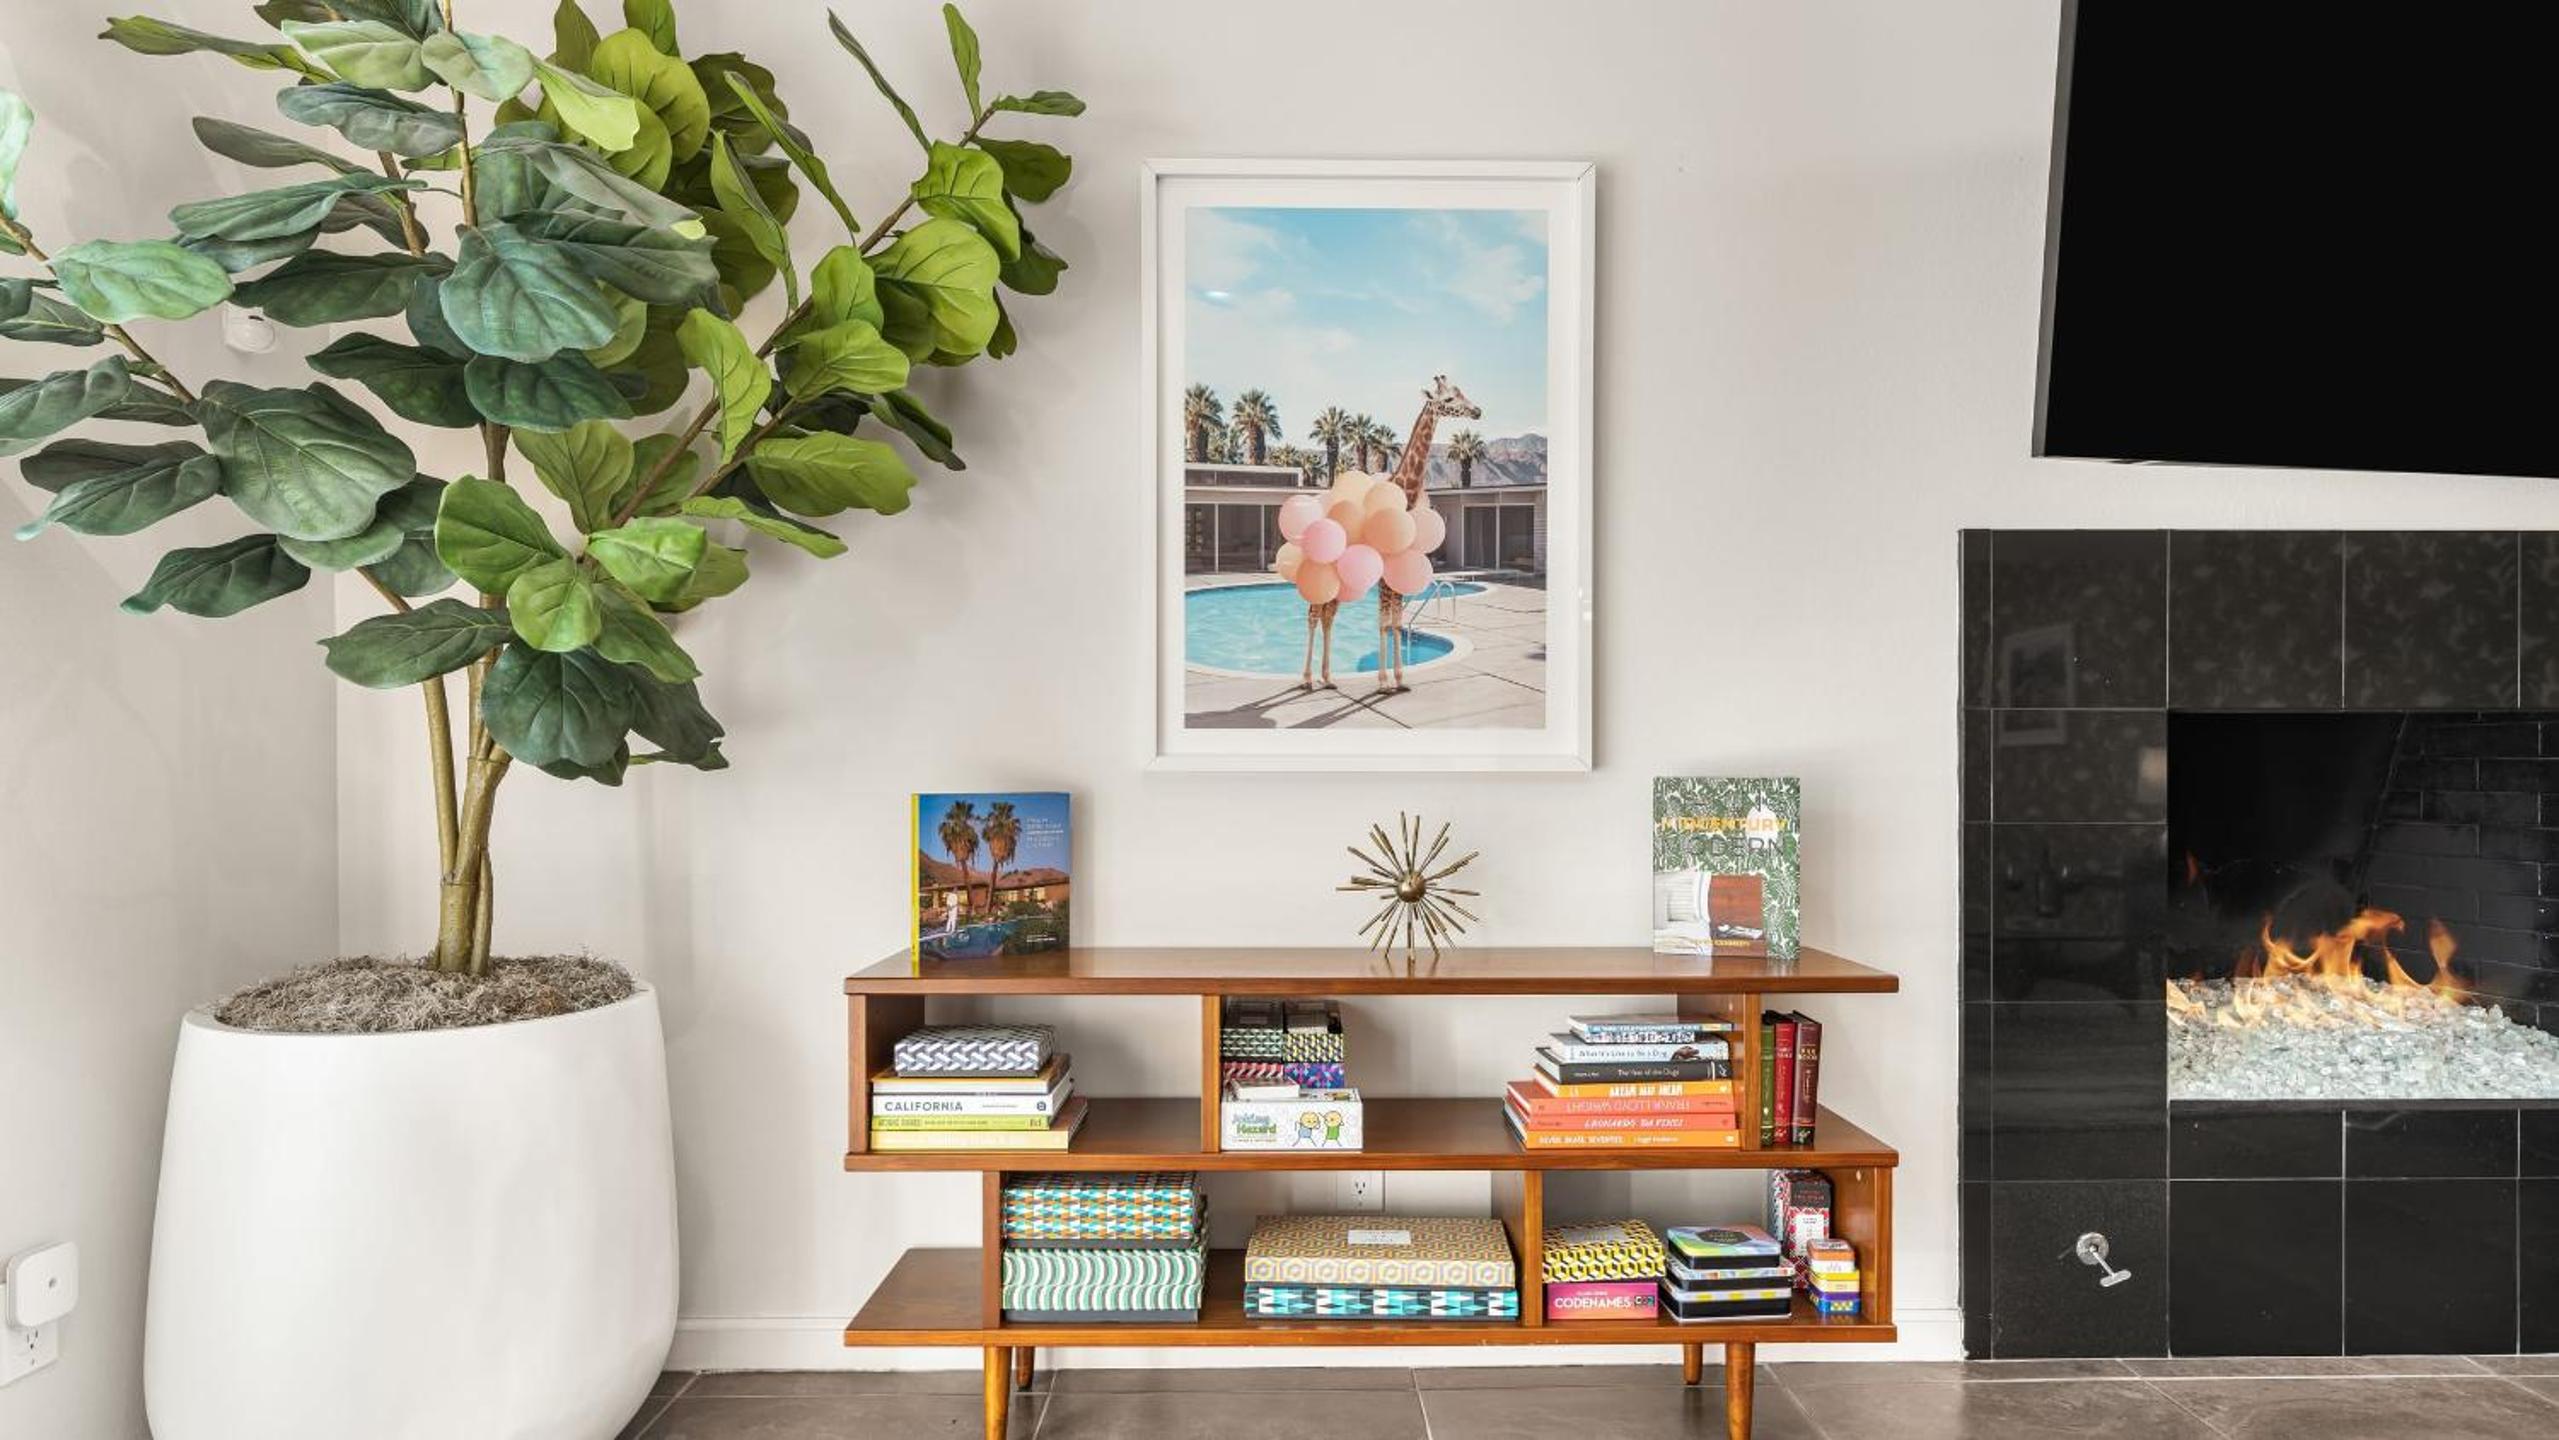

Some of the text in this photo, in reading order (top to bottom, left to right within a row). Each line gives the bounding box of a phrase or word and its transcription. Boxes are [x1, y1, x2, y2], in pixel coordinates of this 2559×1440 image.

[1660, 815, 1787, 832] MIDCENTURY
[884, 1101, 963, 1112] CALIFORNIA
[1554, 1296, 1632, 1309] CODENAMES
